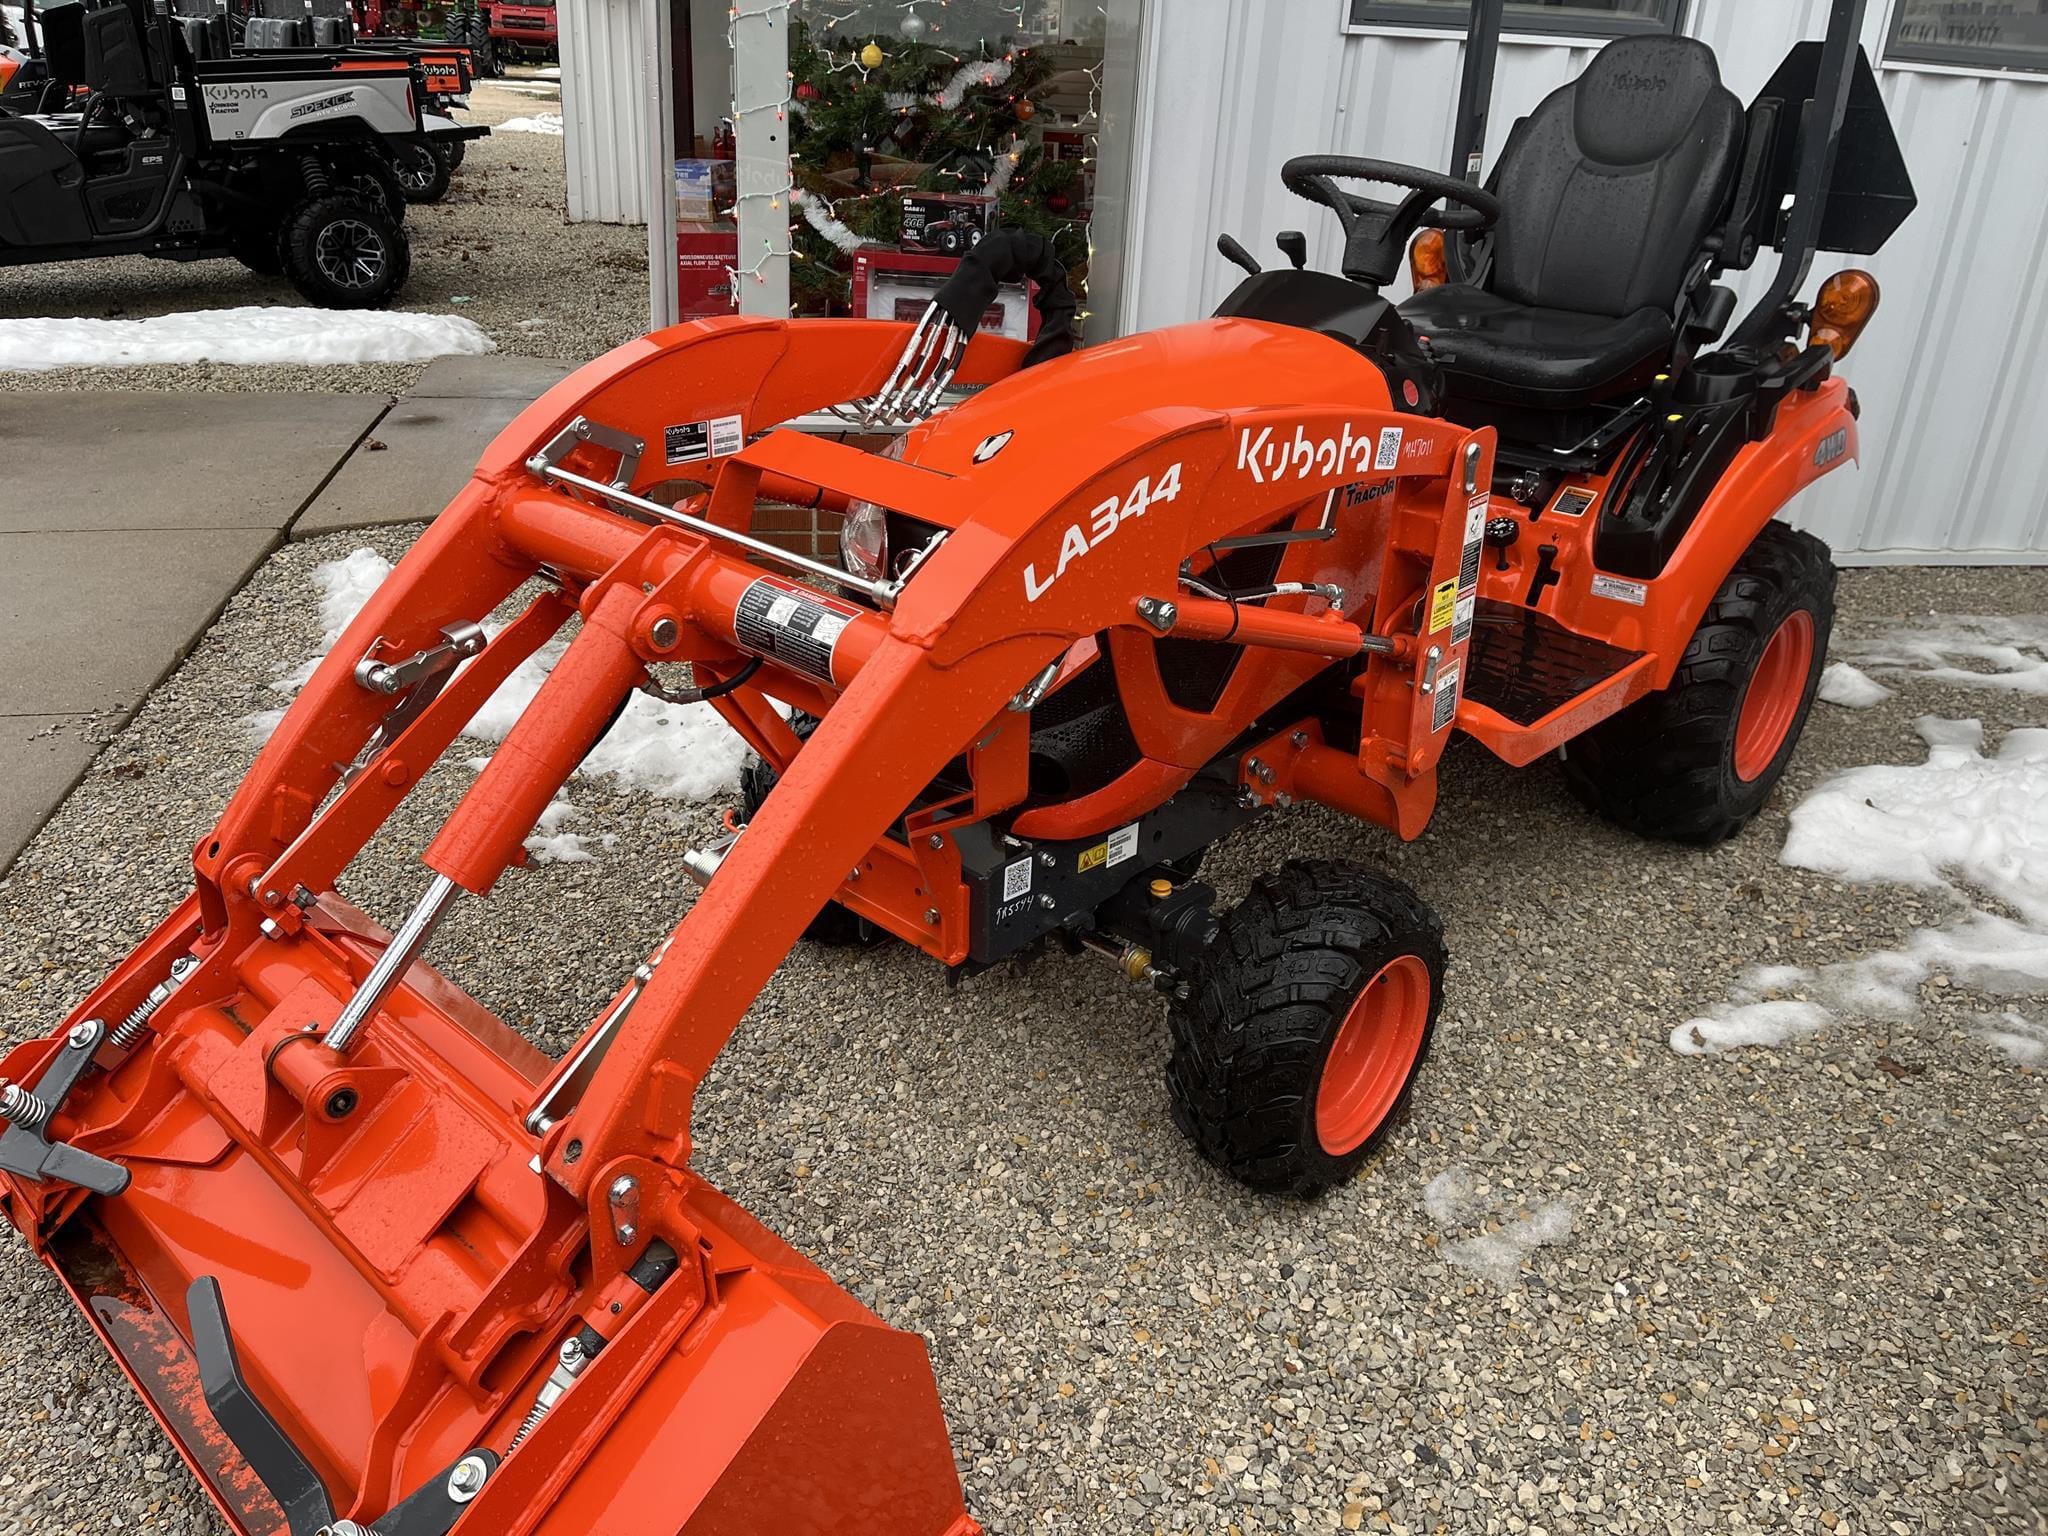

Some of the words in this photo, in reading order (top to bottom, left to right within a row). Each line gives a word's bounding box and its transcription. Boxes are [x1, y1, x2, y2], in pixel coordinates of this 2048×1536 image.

[204, 85, 268, 100] Kubota
[1612, 73, 1667, 91] Kubota
[291, 92, 354, 119] SIDEKICK
[142, 155, 163, 163] EPS
[903, 218, 925, 228] 405
[666, 426, 691, 436] Kubota
[1237, 422, 1372, 483] Kubota
[1814, 428, 1846, 466] 4WD
[1346, 479, 1395, 507] TRACTOR
[1023, 462, 1182, 603] LA344
